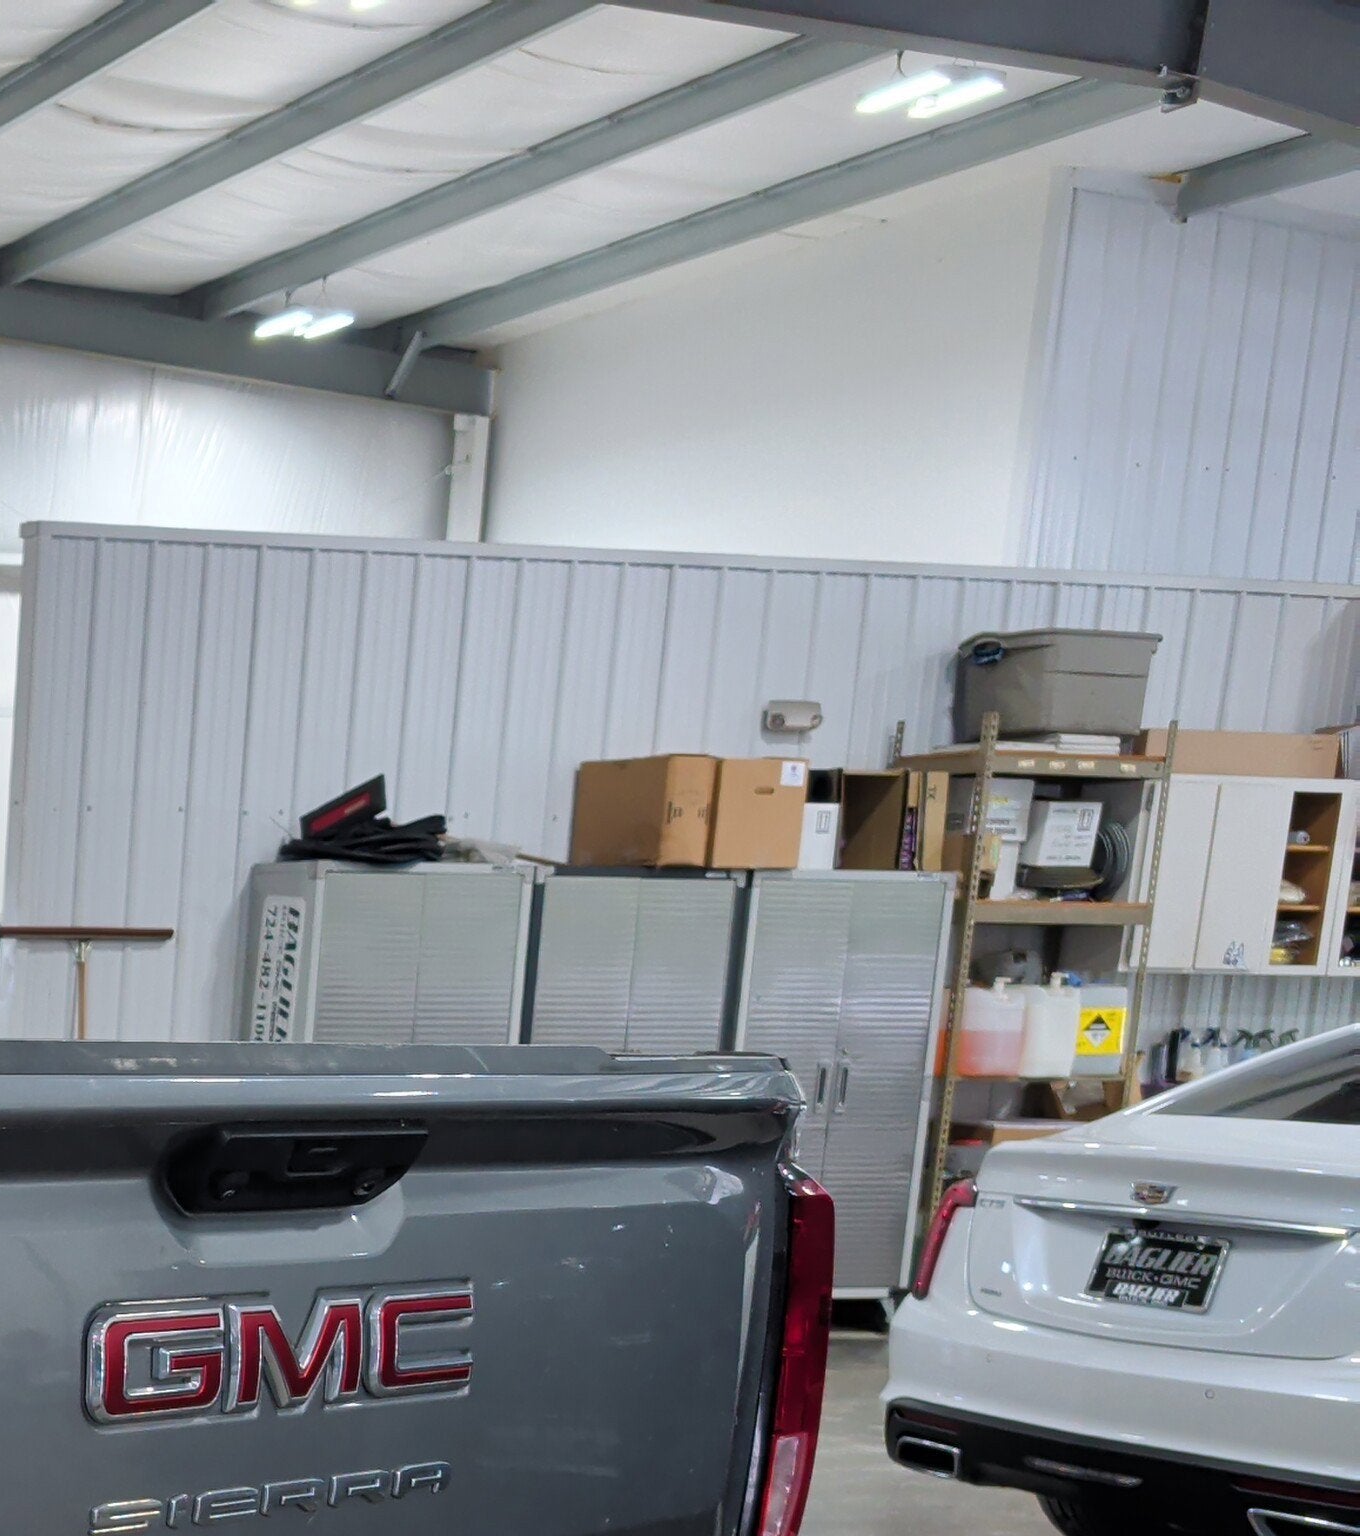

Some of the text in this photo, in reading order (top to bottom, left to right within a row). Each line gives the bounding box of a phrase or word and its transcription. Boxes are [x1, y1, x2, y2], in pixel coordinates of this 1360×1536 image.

[1104, 1243, 1218, 1276] BAGLIER
[1113, 1282, 1180, 1303] BAGLIER
[83, 1278, 474, 1430] GMC
[88, 1461, 452, 1536] SIERRA
